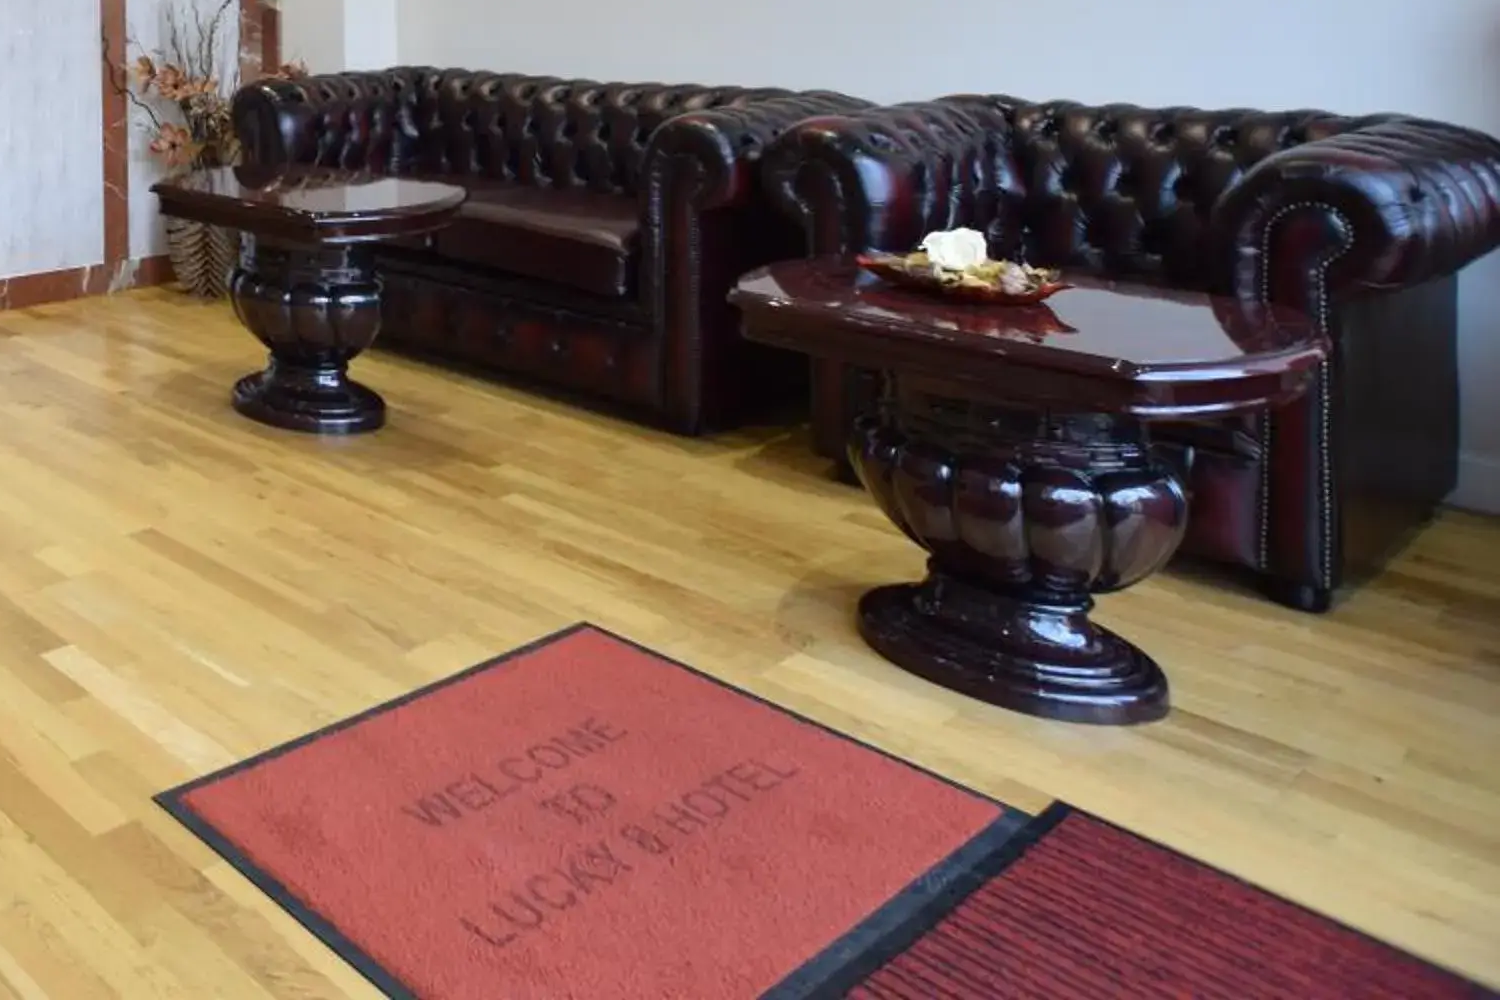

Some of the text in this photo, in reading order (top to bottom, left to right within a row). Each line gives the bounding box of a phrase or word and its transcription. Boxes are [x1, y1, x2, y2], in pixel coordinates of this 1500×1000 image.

[402, 716, 629, 828] WELCOME
[538, 781, 618, 826] TO
[459, 840, 632, 948] LUCKY
[654, 757, 802, 836] HOTEL
